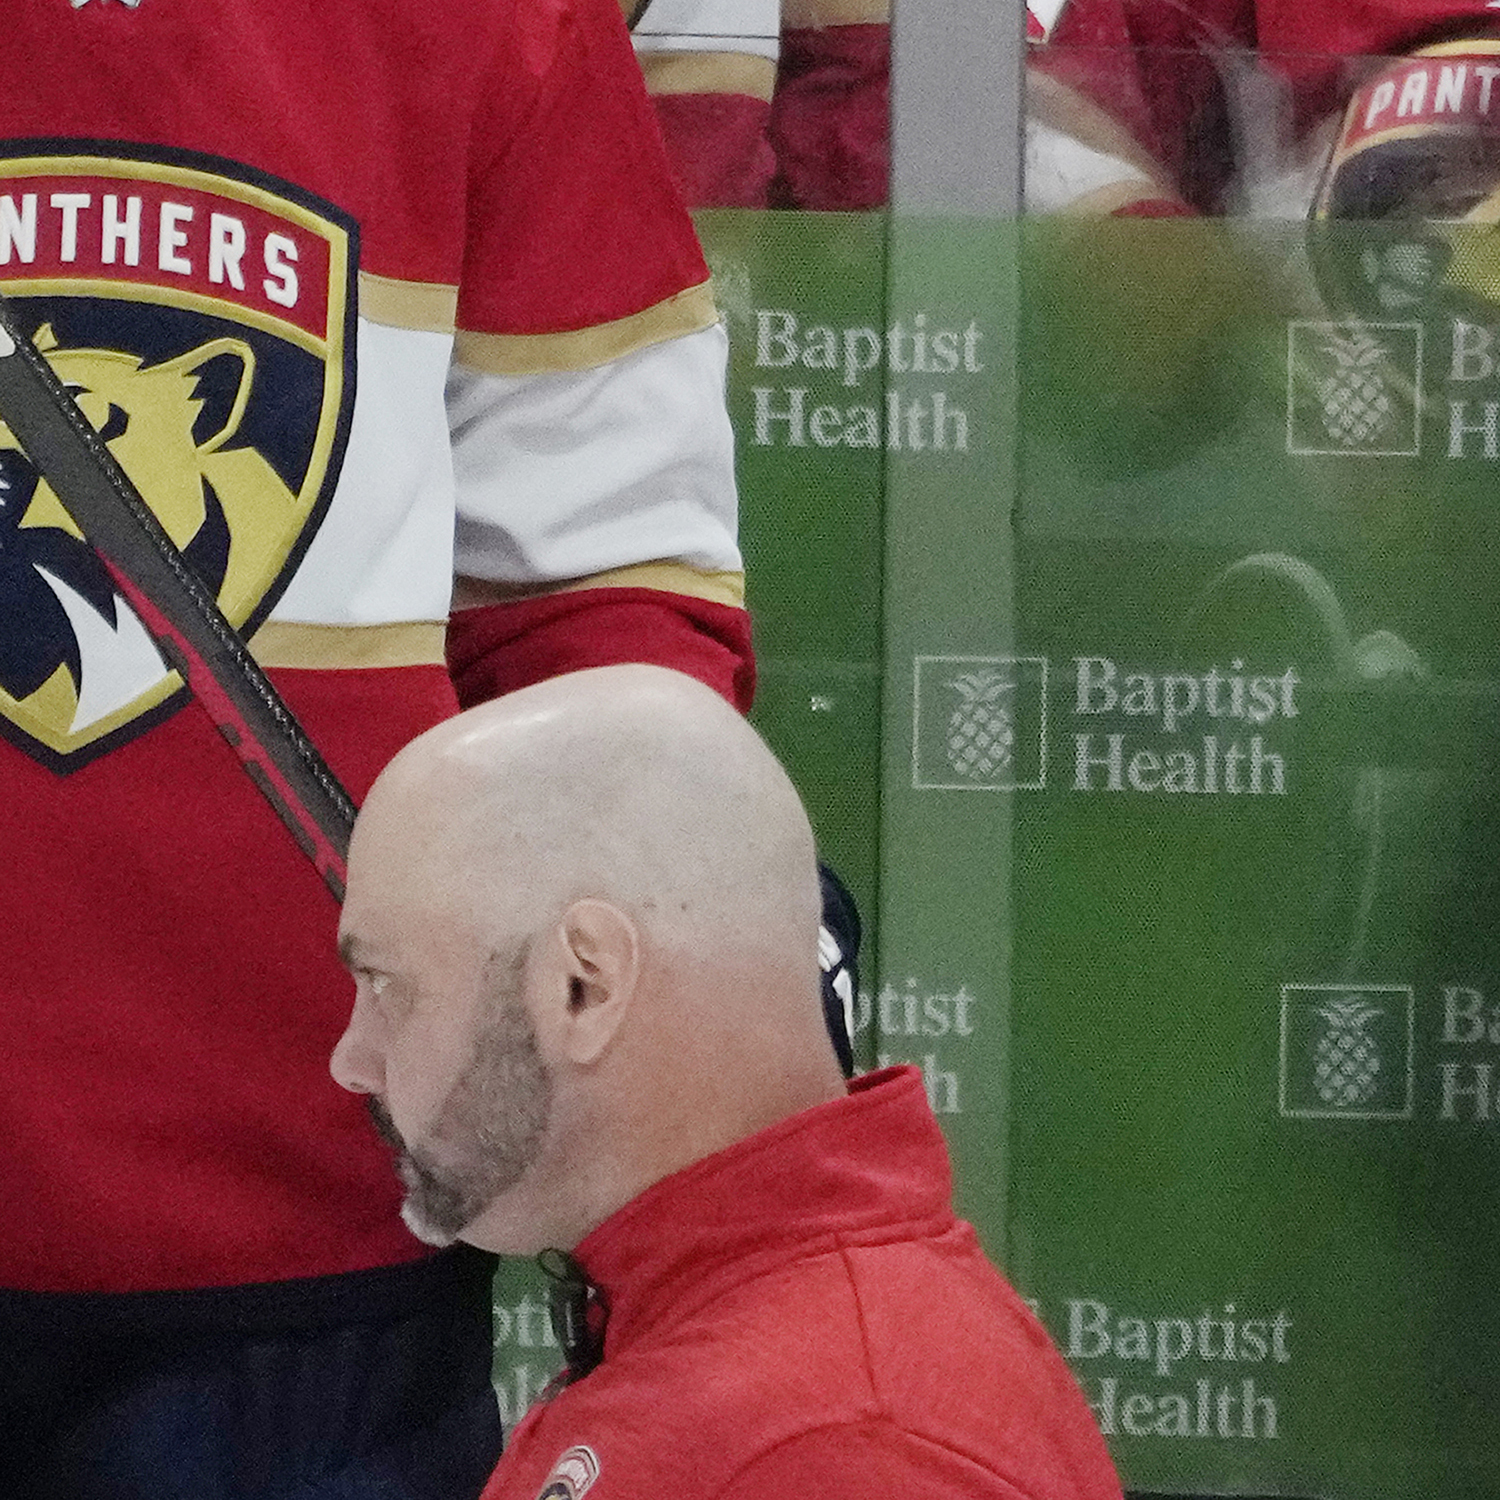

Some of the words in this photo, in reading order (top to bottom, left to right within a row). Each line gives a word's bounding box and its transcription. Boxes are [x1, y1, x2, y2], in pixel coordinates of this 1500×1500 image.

[0, 193, 300, 309] NTHERS
[753, 309, 986, 388] Baptist
[752, 386, 970, 451] Health
[1072, 657, 1301, 734] Baptist
[1069, 733, 1288, 796] Health
[1063, 1299, 1294, 1377] Baptist
